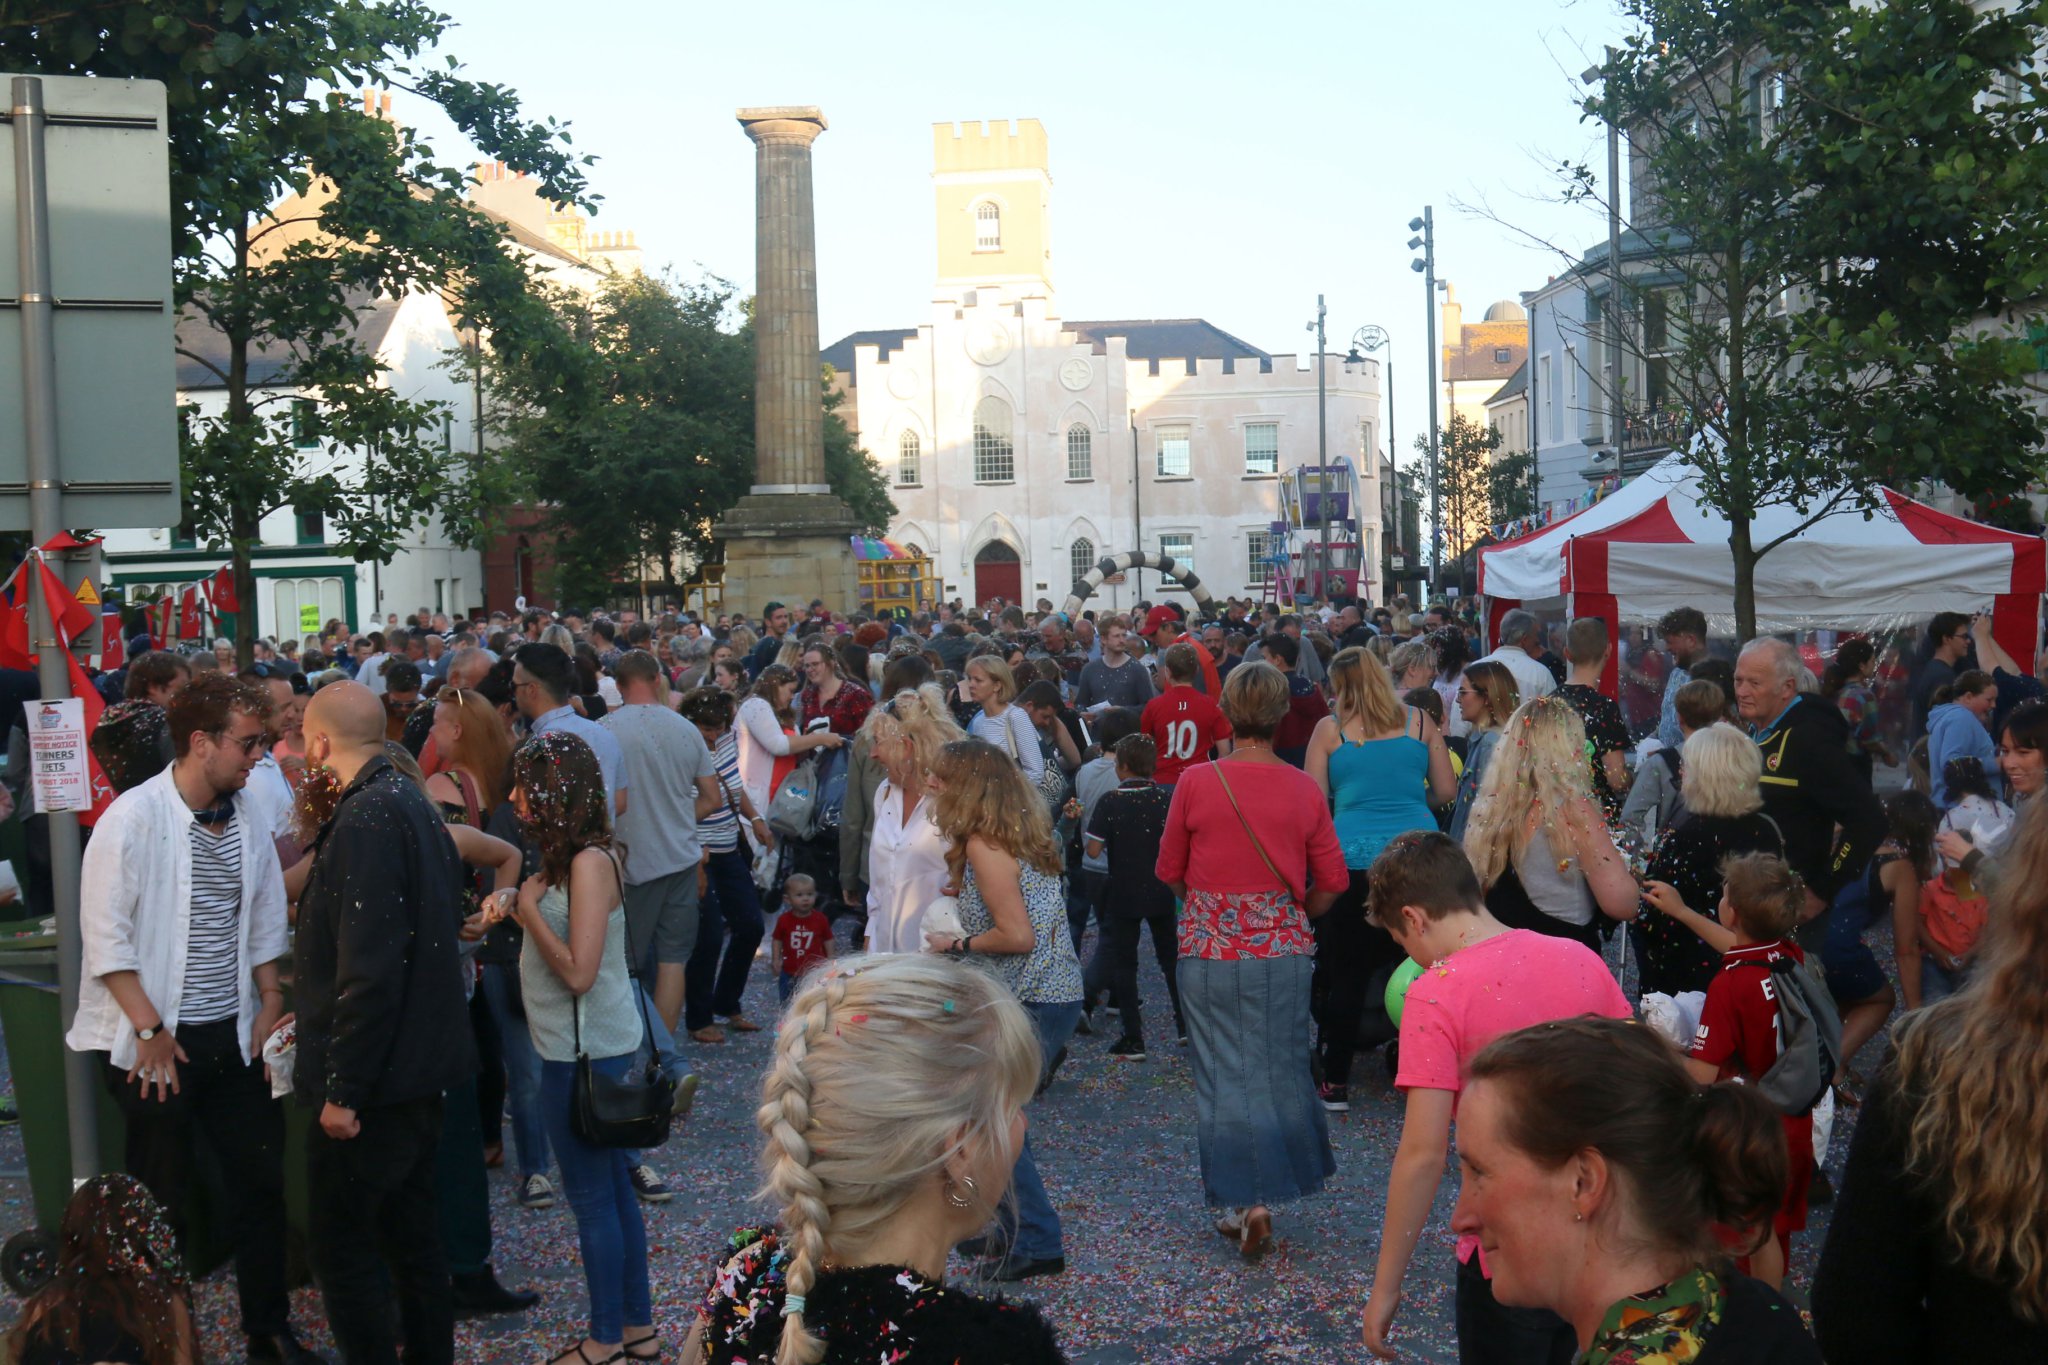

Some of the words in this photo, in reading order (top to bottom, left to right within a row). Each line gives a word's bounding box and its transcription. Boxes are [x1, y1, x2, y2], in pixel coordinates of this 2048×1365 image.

[51, 741, 77, 749] NOTICE
[1163, 719, 1198, 760] 10
[791, 931, 813, 949] 67
[796, 949, 805, 958] P
